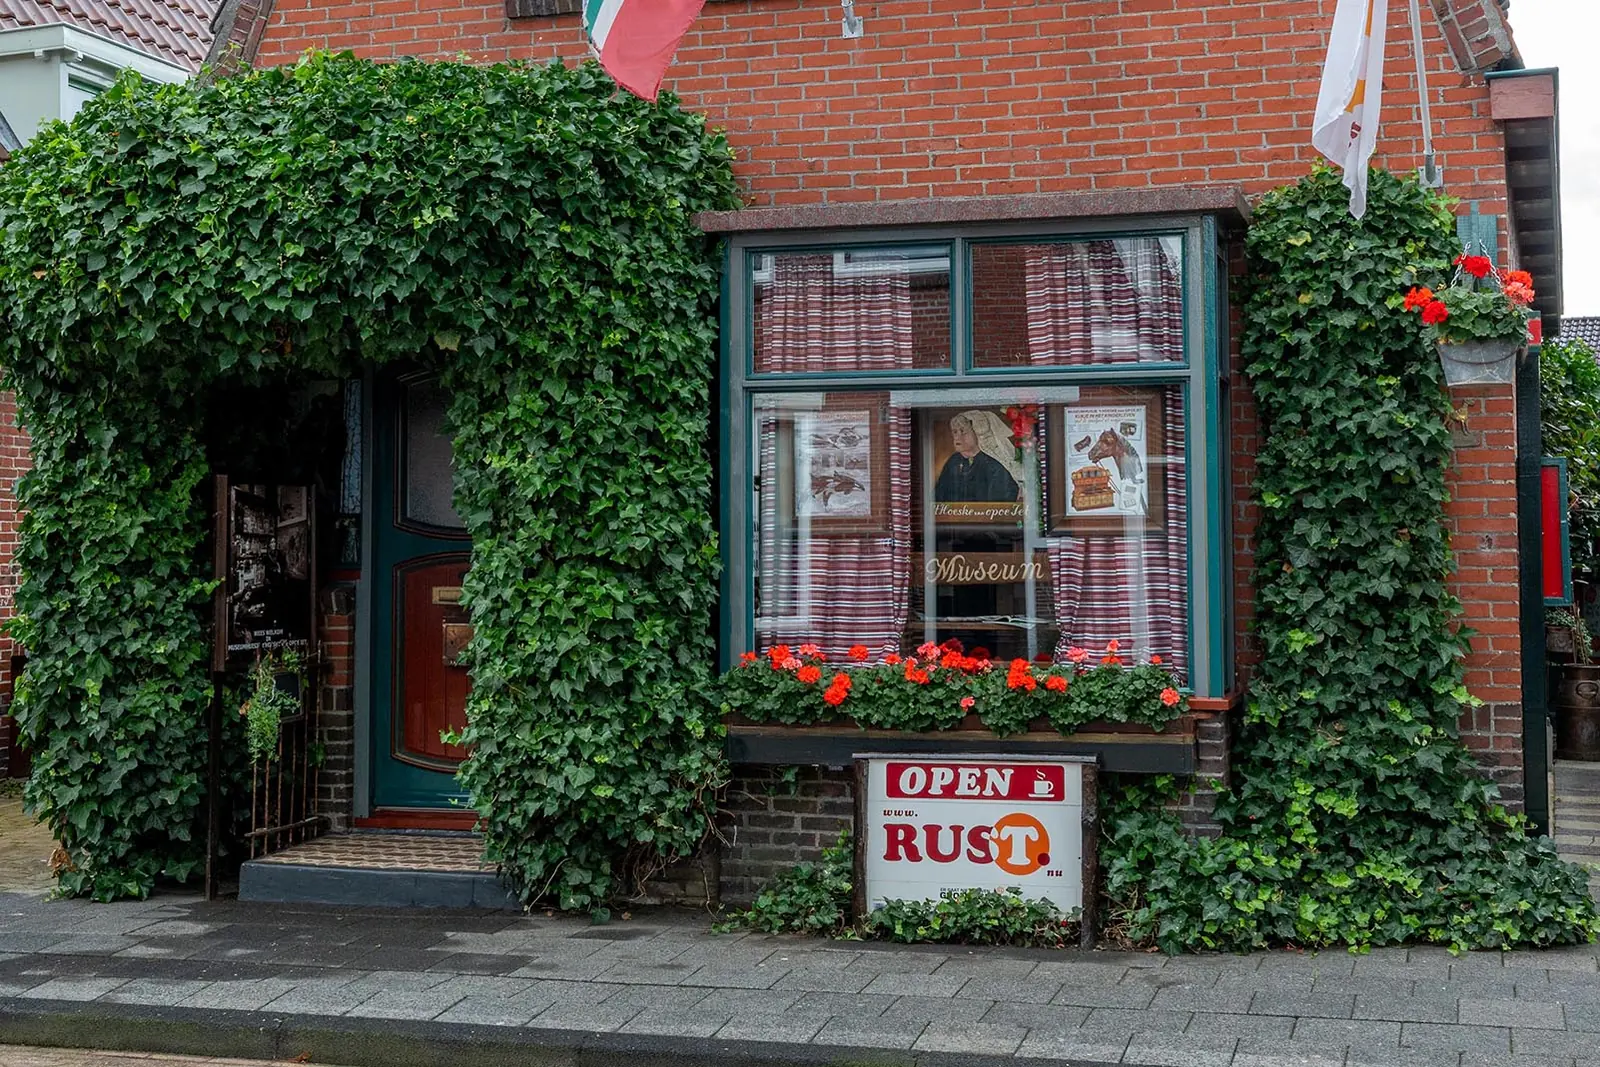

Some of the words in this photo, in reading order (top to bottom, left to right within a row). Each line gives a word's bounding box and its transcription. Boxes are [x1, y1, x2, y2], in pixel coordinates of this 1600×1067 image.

[925, 555, 1044, 582] Museum
[899, 766, 1014, 797] OPEN
[882, 808, 919, 818] www.
[1046, 869, 1064, 878] nu
